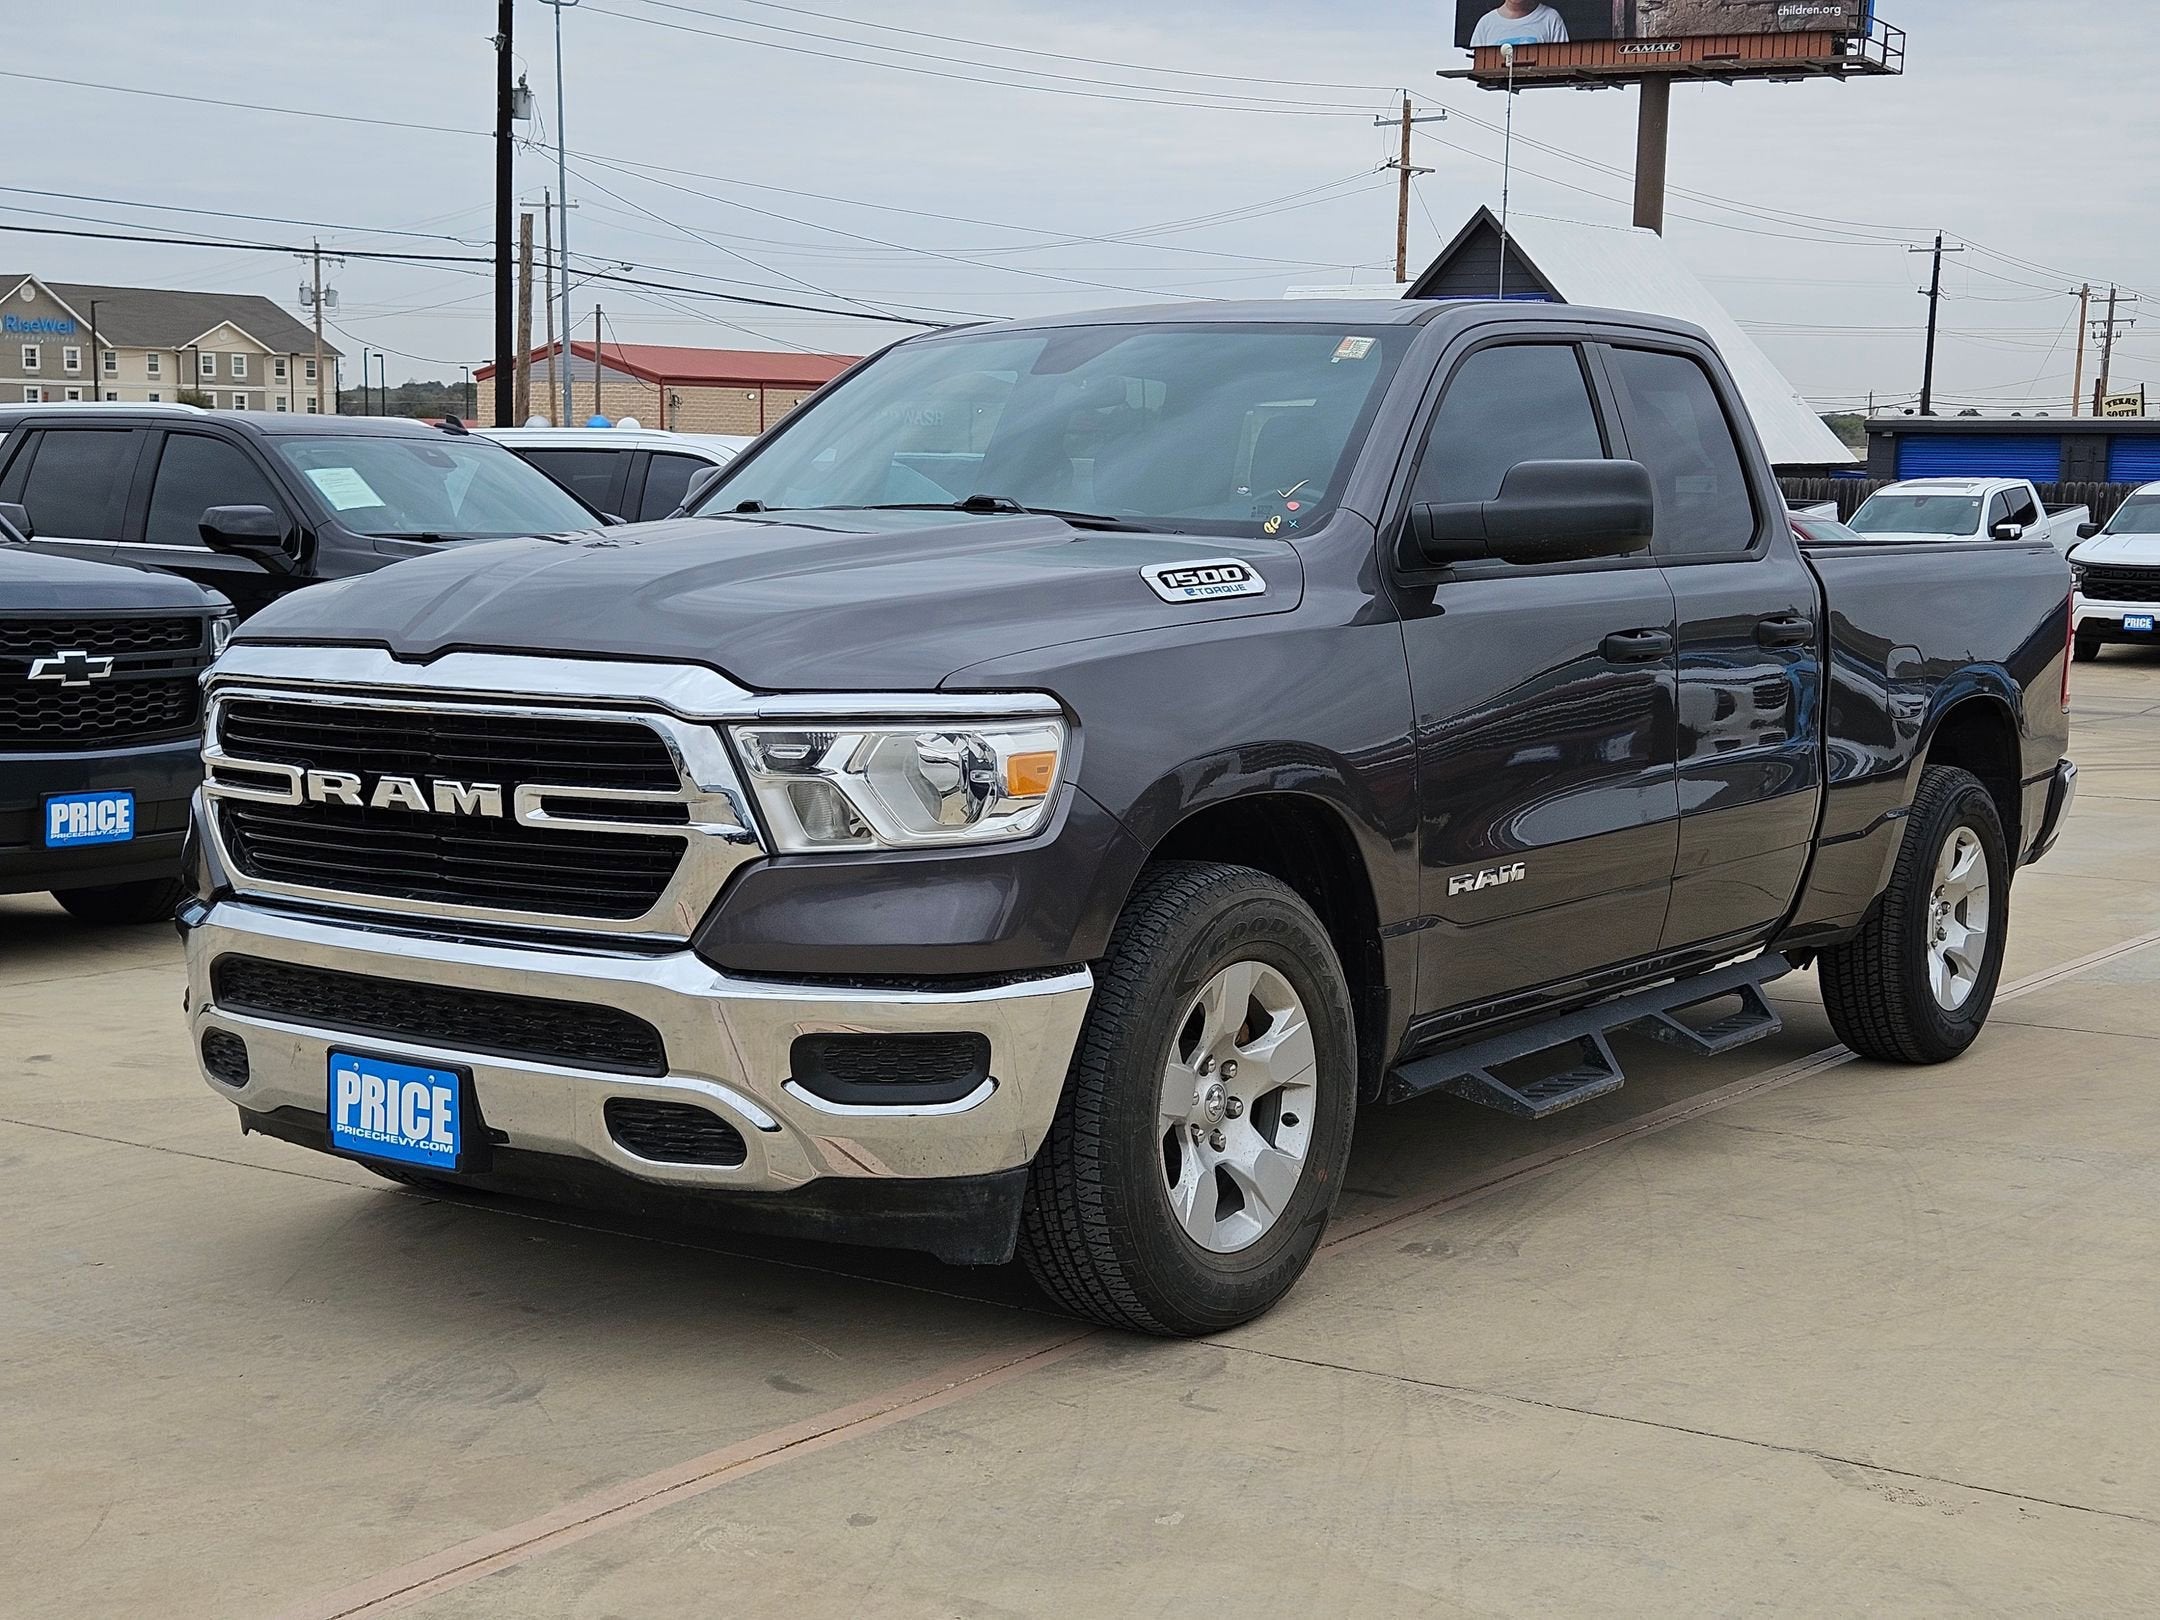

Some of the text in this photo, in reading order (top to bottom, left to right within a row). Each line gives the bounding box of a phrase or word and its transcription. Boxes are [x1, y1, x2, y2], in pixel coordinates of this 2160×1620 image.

[1777, 5, 1841, 16] children.org
[1623, 43, 1675, 53] LAMAR
[4, 313, 76, 335] RiseWell
[2105, 397, 2138, 408] TEXAS
[2106, 408, 2138, 417] SOUTH
[1160, 567, 1244, 587] 1500
[2123, 617, 2153, 629] PRICE
[307, 769, 503, 818] RAM
[50, 799, 130, 834] PRICE
[50, 828, 130, 839] PRICECHEVY.COM
[1448, 862, 1526, 896] RAM
[336, 1069, 454, 1145] PRICE
[336, 1123, 454, 1154] PRICECHEVY.COM
